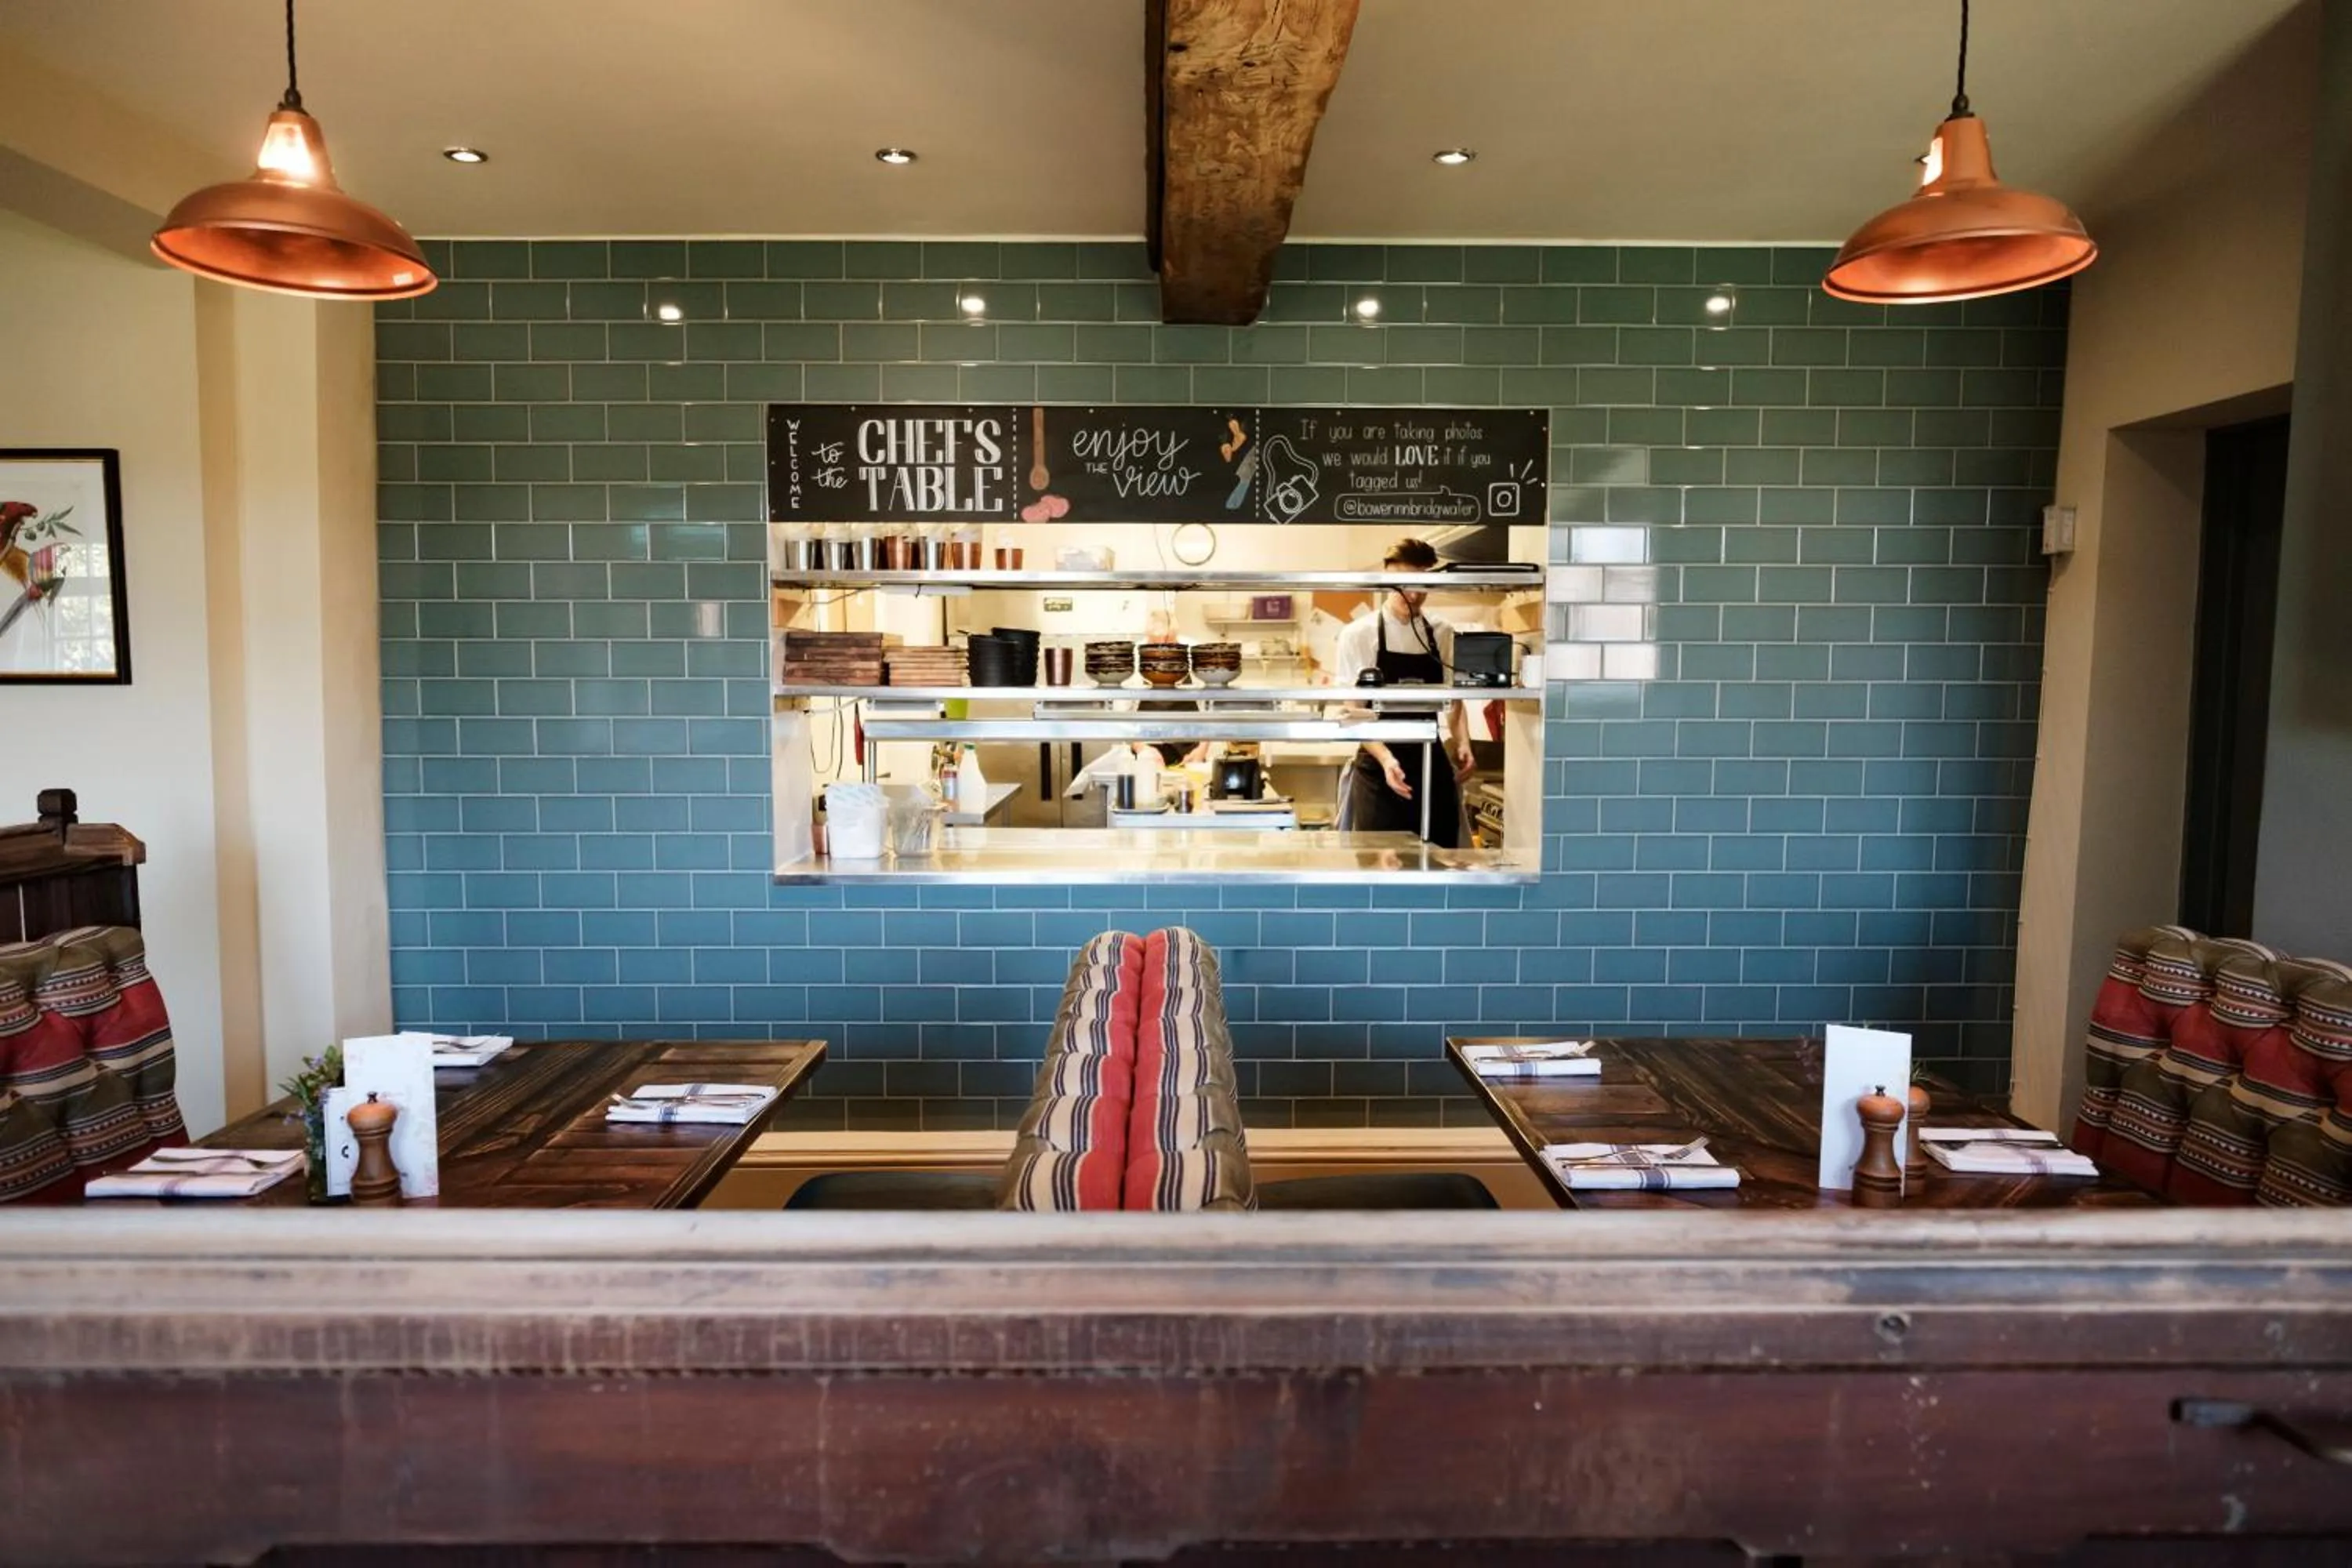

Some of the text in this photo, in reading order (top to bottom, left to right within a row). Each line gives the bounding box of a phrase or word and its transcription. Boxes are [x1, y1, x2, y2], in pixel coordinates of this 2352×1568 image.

[1299, 418, 1483, 444] If you are taking photos
[811, 441, 844, 464] to
[1073, 423, 1190, 471] enjoy
[1322, 444, 1492, 468] we would LOVE it if you
[786, 419, 801, 509] WELCOME
[1084, 461, 1108, 475] THE
[811, 466, 848, 489] the
[858, 466, 1004, 512] TABLE
[1112, 465, 1203, 499] view
[1349, 469, 1423, 492] tagged us!
